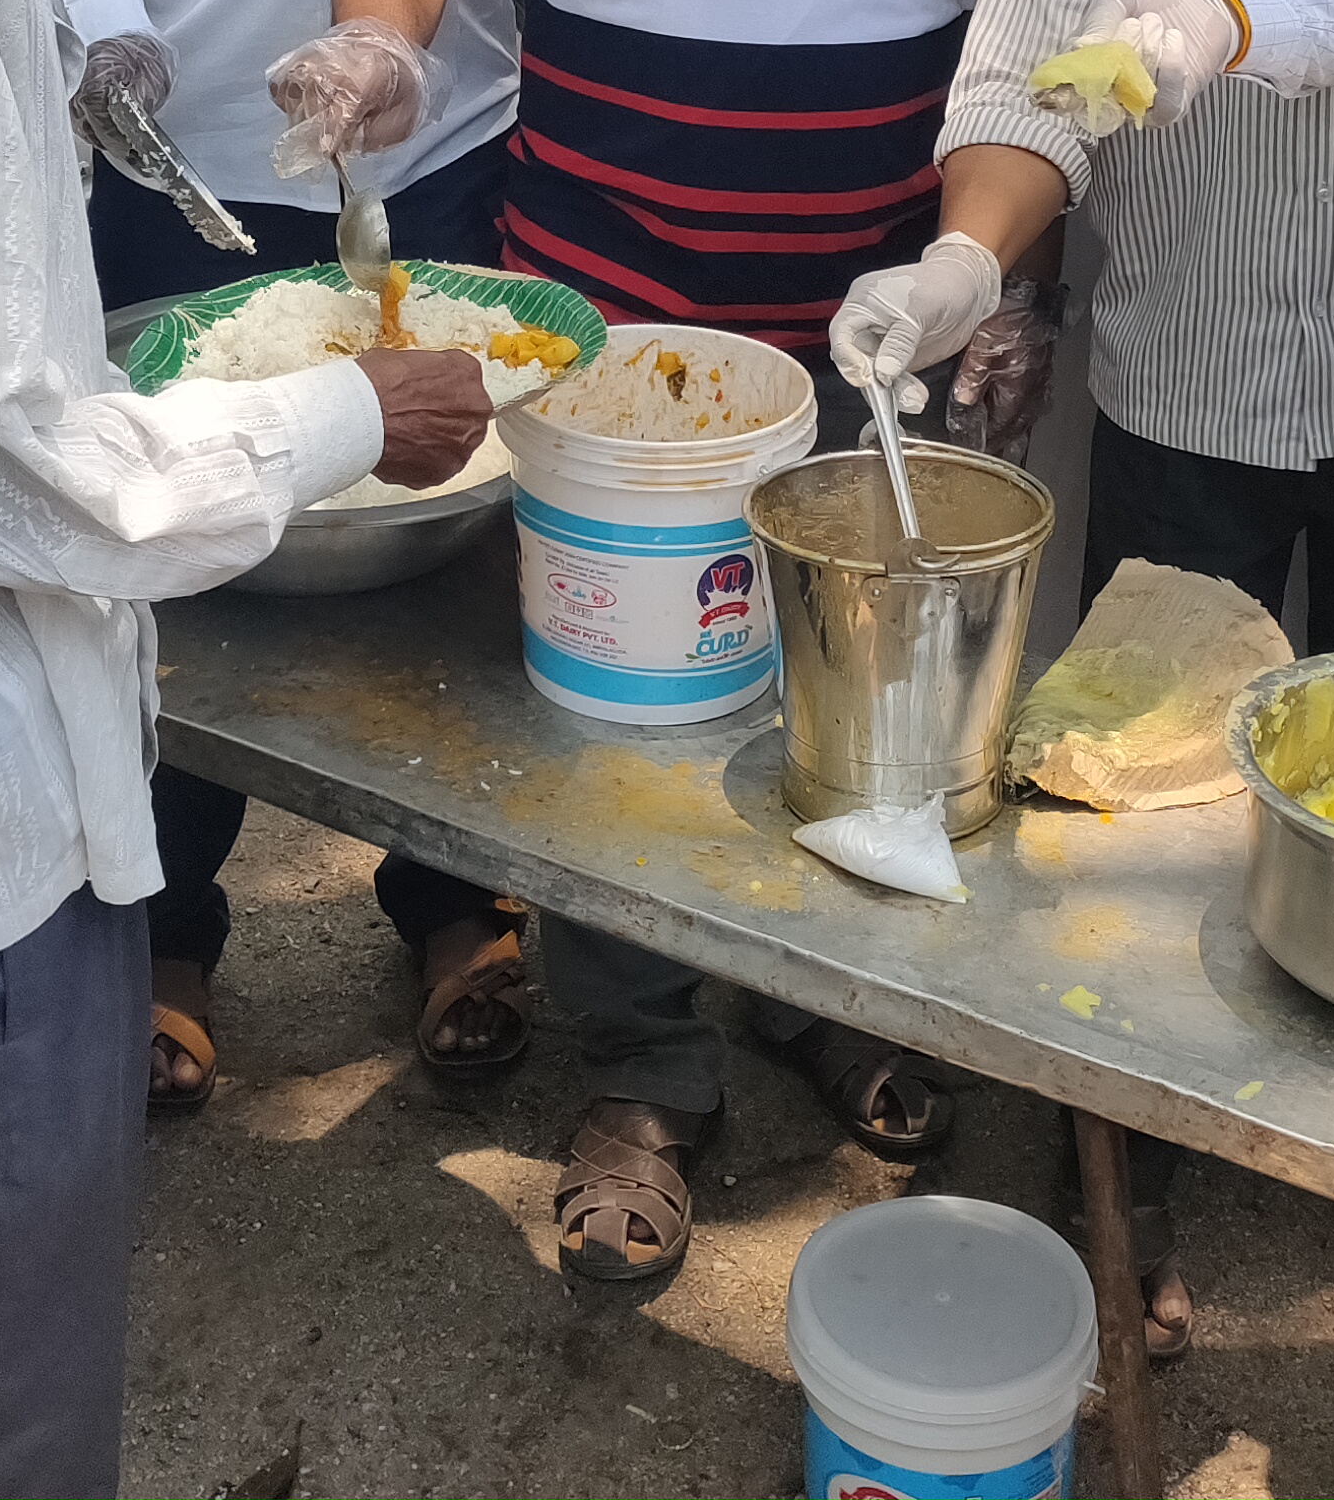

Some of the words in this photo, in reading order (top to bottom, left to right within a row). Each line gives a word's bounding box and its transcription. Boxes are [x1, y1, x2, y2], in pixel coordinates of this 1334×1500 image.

[711, 562, 744, 589] VT
[560, 623, 581, 636] DAIRY
[582, 631, 599, 642] PVT.
[600, 636, 619, 646] LTD.
[696, 630, 749, 656] CURD
